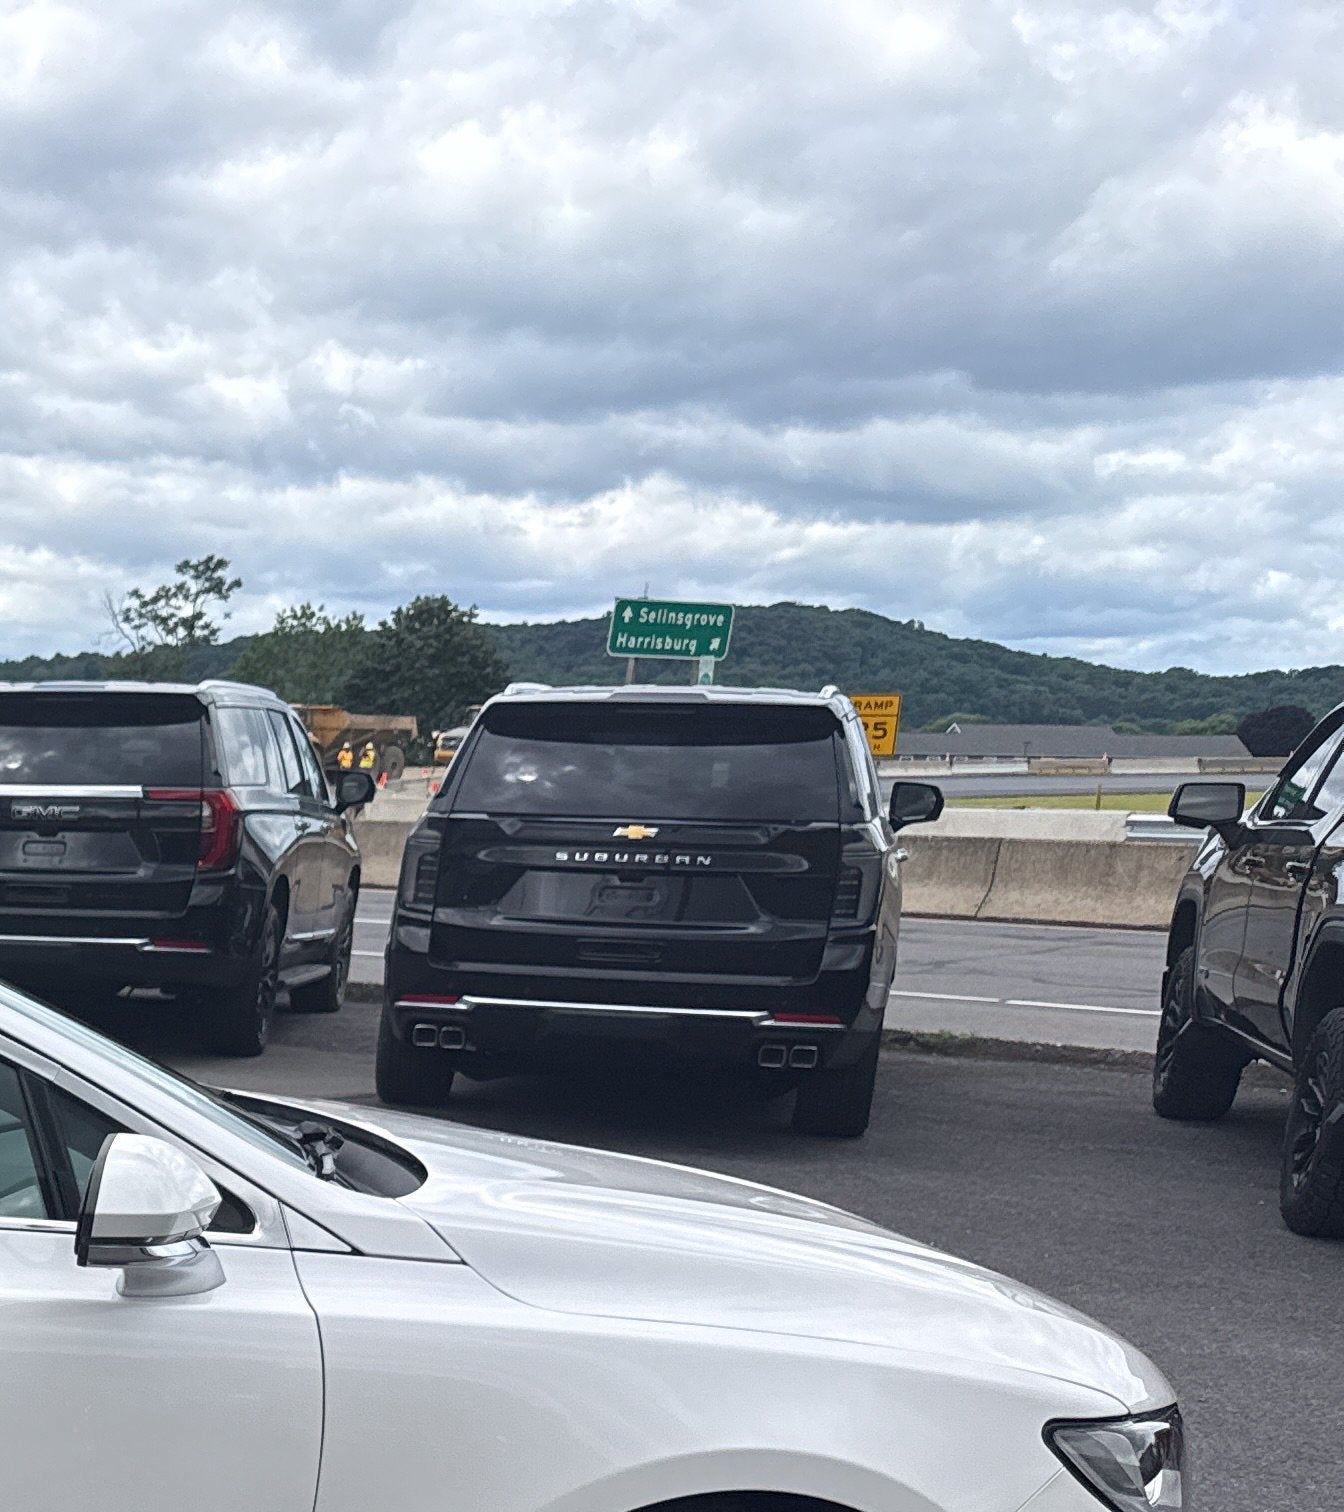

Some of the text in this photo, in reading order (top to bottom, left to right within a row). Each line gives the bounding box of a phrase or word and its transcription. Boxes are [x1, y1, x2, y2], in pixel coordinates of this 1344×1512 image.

[638, 606, 725, 630] Selinsgrove
[616, 632, 698, 656] Harrisburg
[853, 700, 894, 711] RAMP
[11, 805, 81, 820] GMC
[555, 851, 712, 866] SUBURBAN
